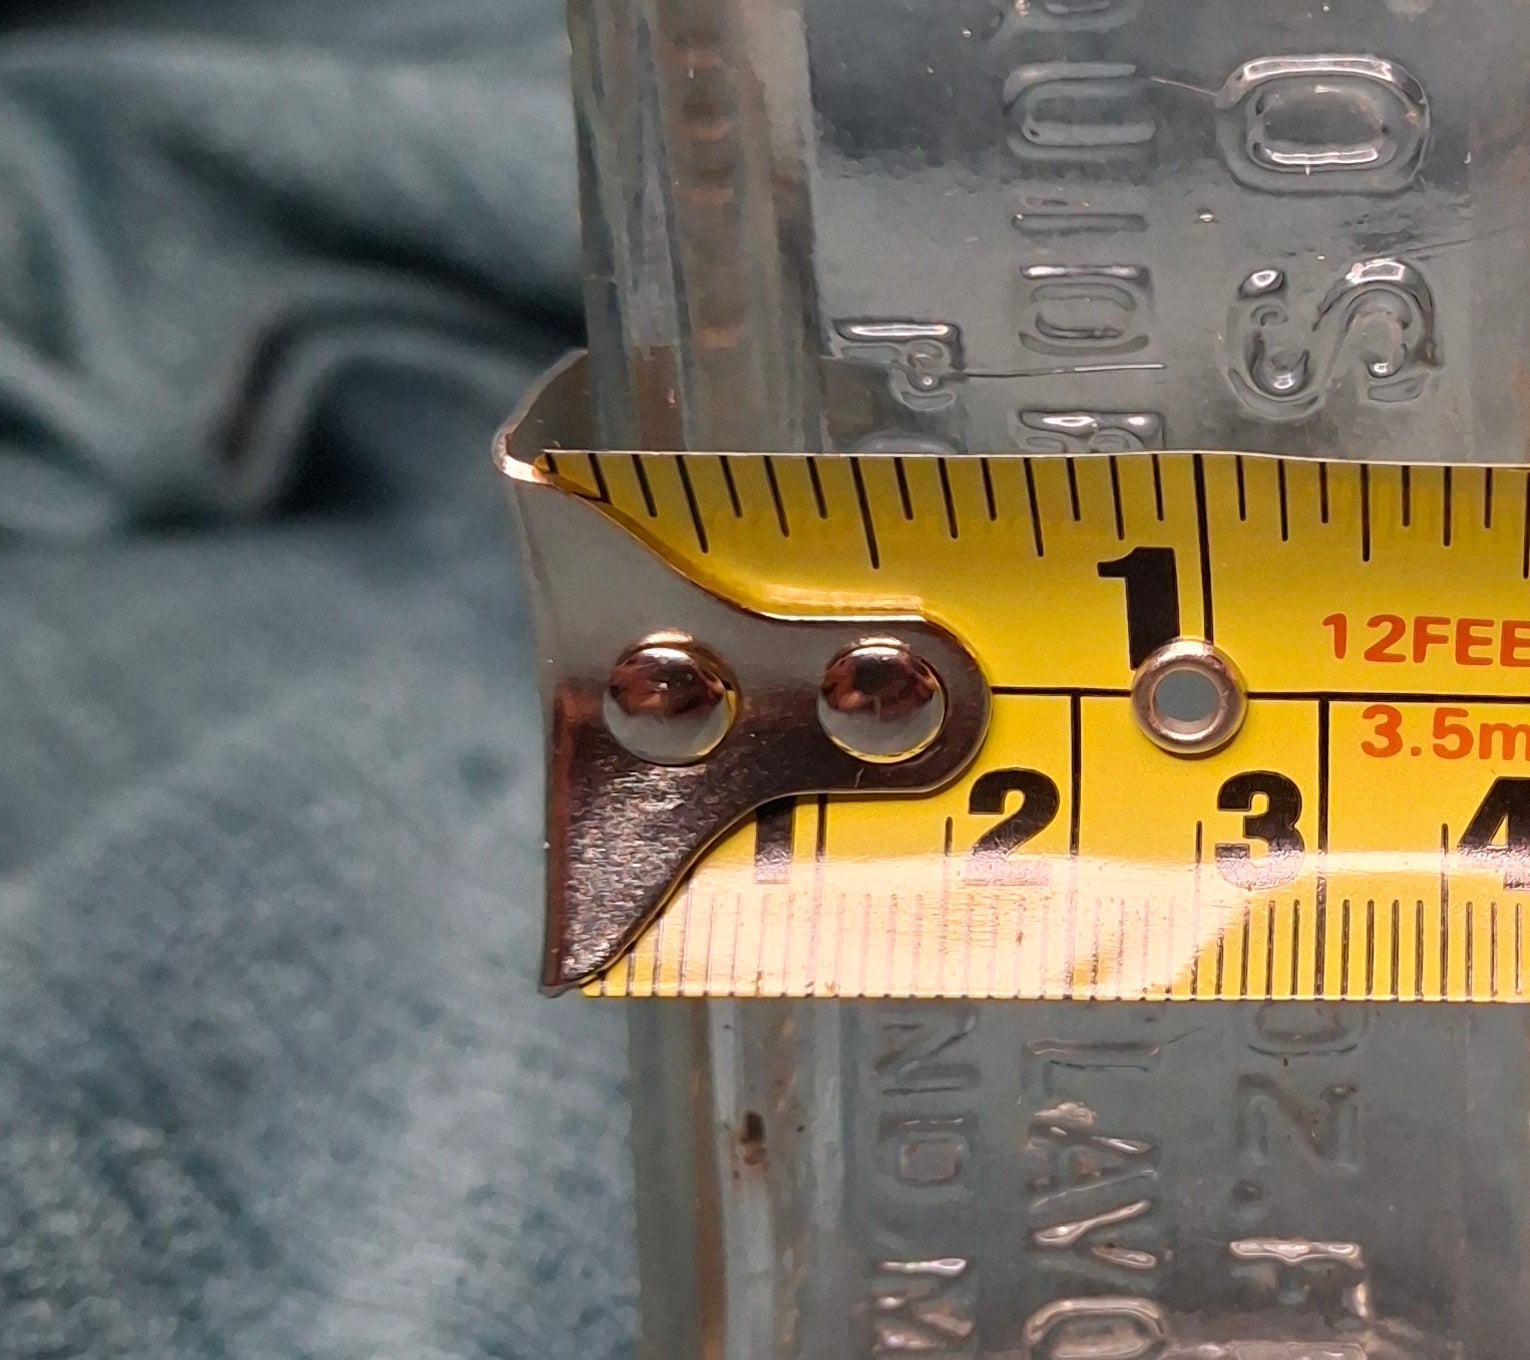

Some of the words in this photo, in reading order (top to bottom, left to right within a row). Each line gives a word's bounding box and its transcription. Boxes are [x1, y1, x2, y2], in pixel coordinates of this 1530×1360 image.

[1097, 546, 1181, 671] 1
[961, 767, 1061, 886] 2
[1215, 771, 1303, 891] 3
